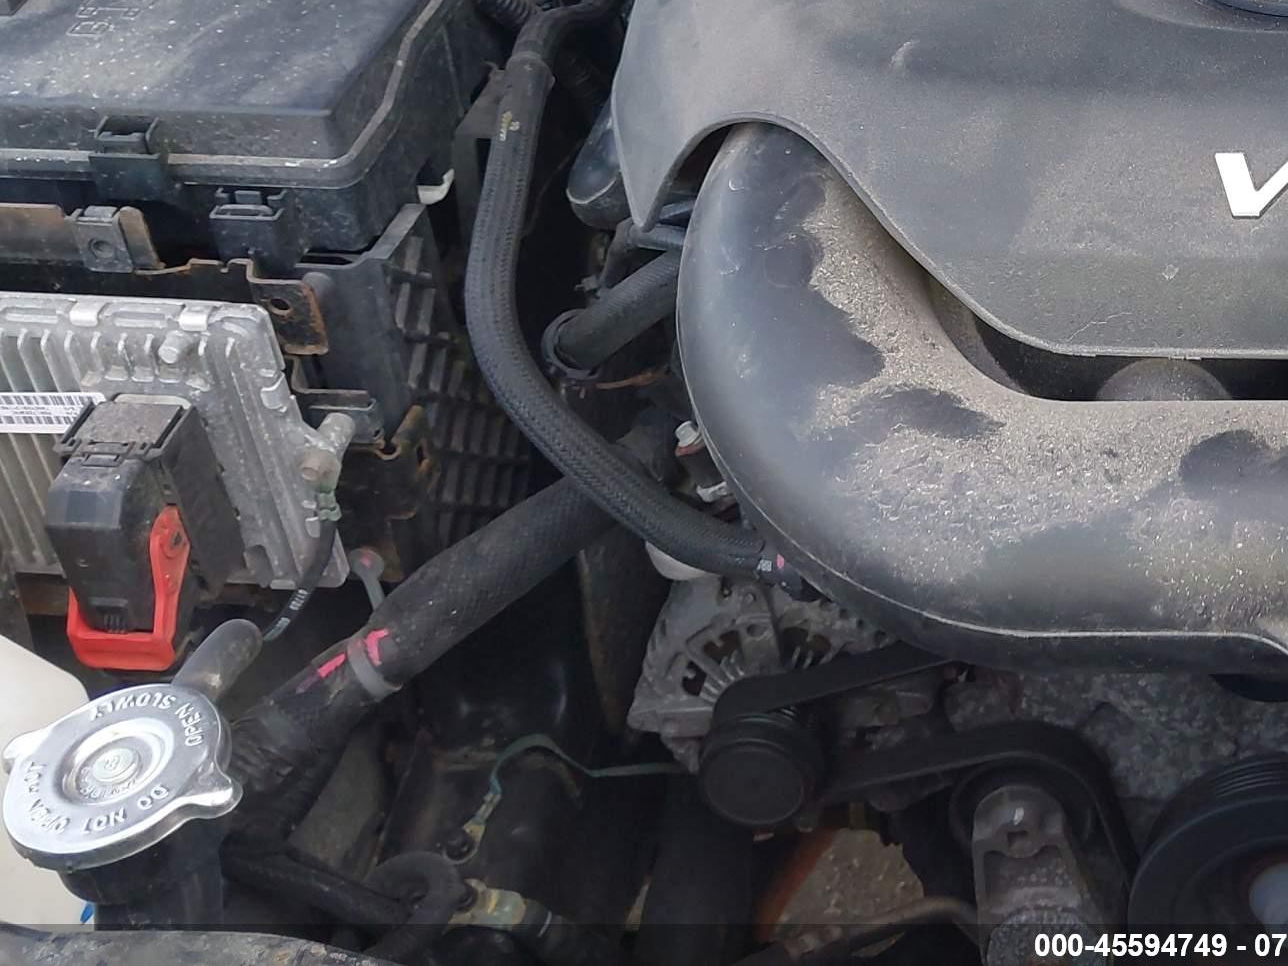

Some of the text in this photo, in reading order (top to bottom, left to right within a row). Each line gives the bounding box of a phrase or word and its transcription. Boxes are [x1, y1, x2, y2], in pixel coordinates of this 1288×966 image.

[90, 692, 204, 747] OPEN SLOWLY
[137, 785, 169, 811] DO
[80, 807, 128, 835] NOT
